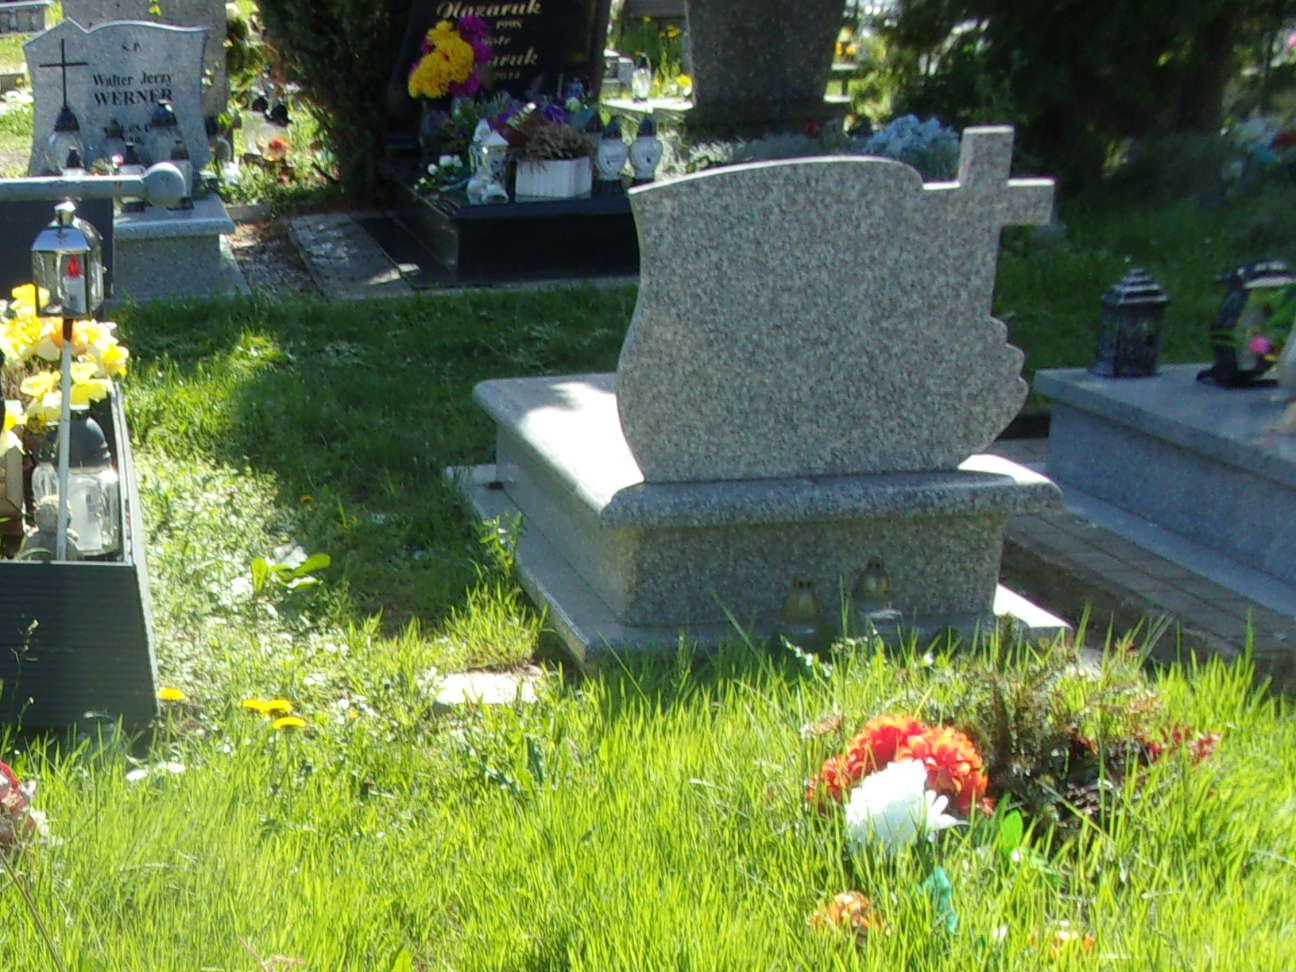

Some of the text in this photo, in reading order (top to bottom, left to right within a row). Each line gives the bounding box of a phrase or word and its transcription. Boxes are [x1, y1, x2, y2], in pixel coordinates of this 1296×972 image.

[93, 71, 174, 86] Walter Jerzy
[94, 87, 173, 105] WERNER
